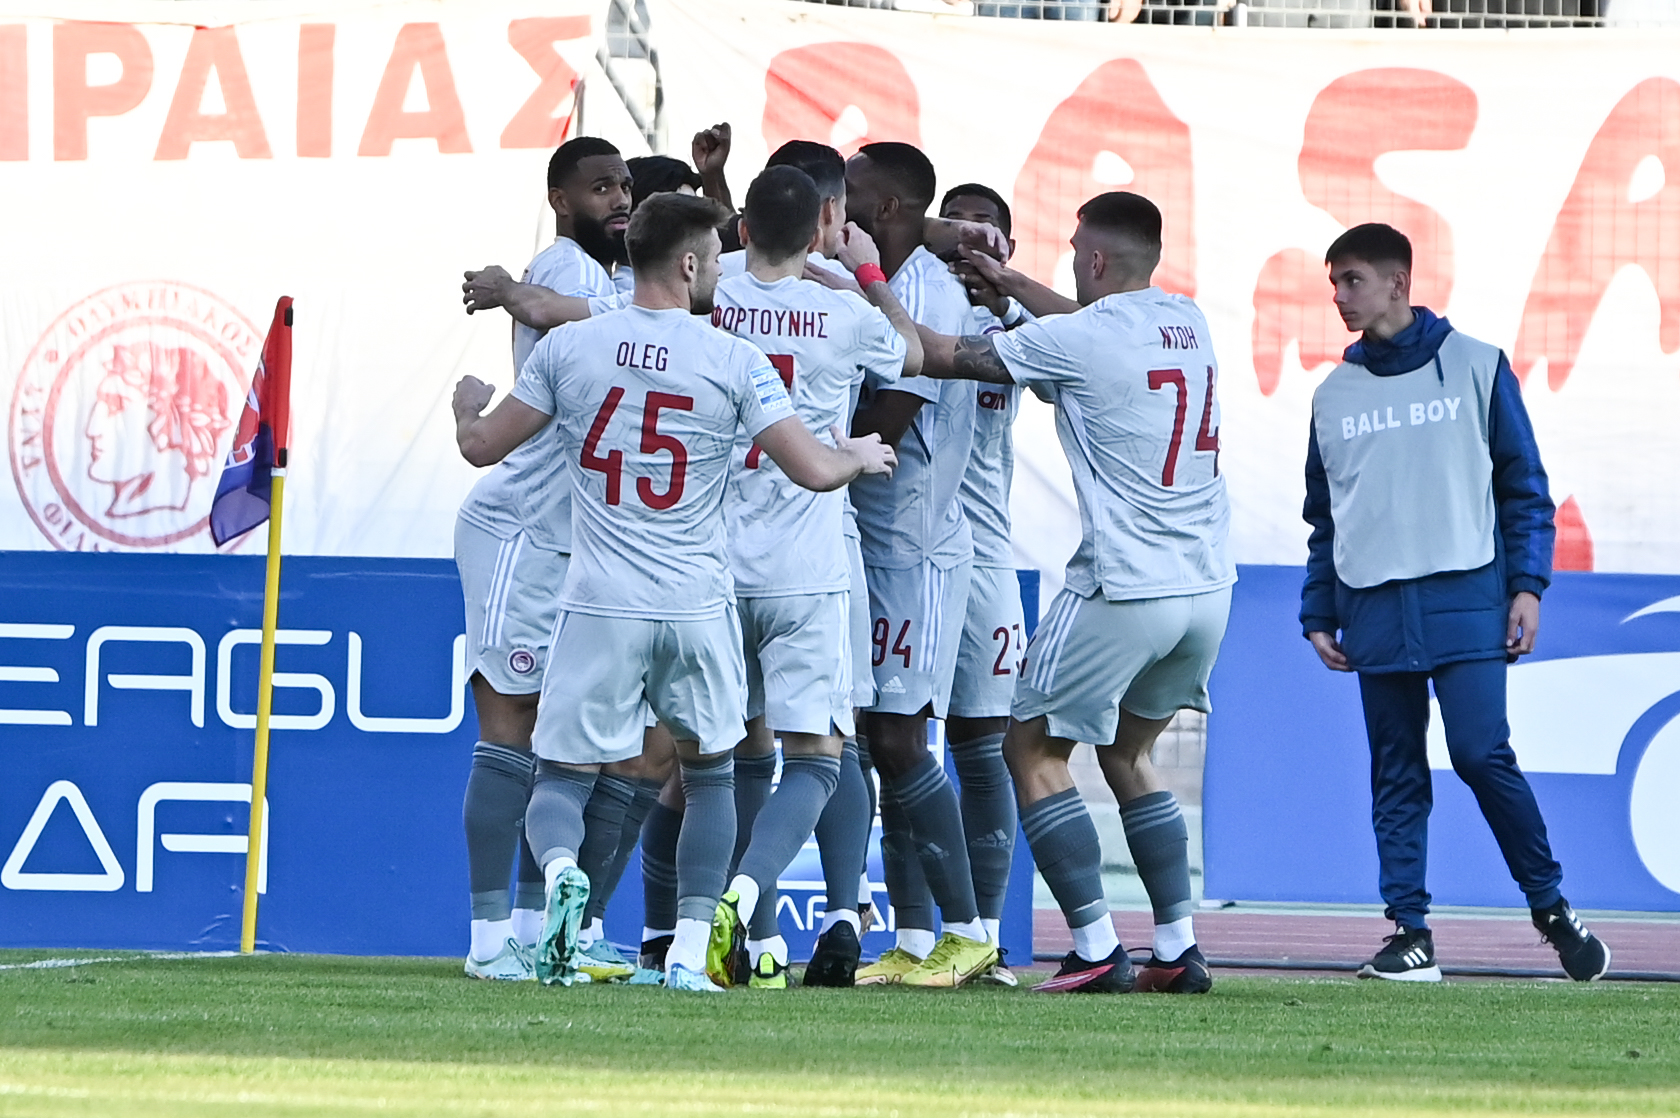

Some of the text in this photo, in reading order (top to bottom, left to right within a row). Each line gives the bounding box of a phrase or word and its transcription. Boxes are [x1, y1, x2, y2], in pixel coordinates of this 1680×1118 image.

[711, 304, 828, 339] ΦΟΡΤΟΥΝΗΣ
[616, 341, 669, 372] OLEG
[1147, 365, 1221, 487] 74
[1342, 396, 1461, 440] BALL BOY
[580, 386, 694, 510] 45
[872, 617, 911, 668] 94
